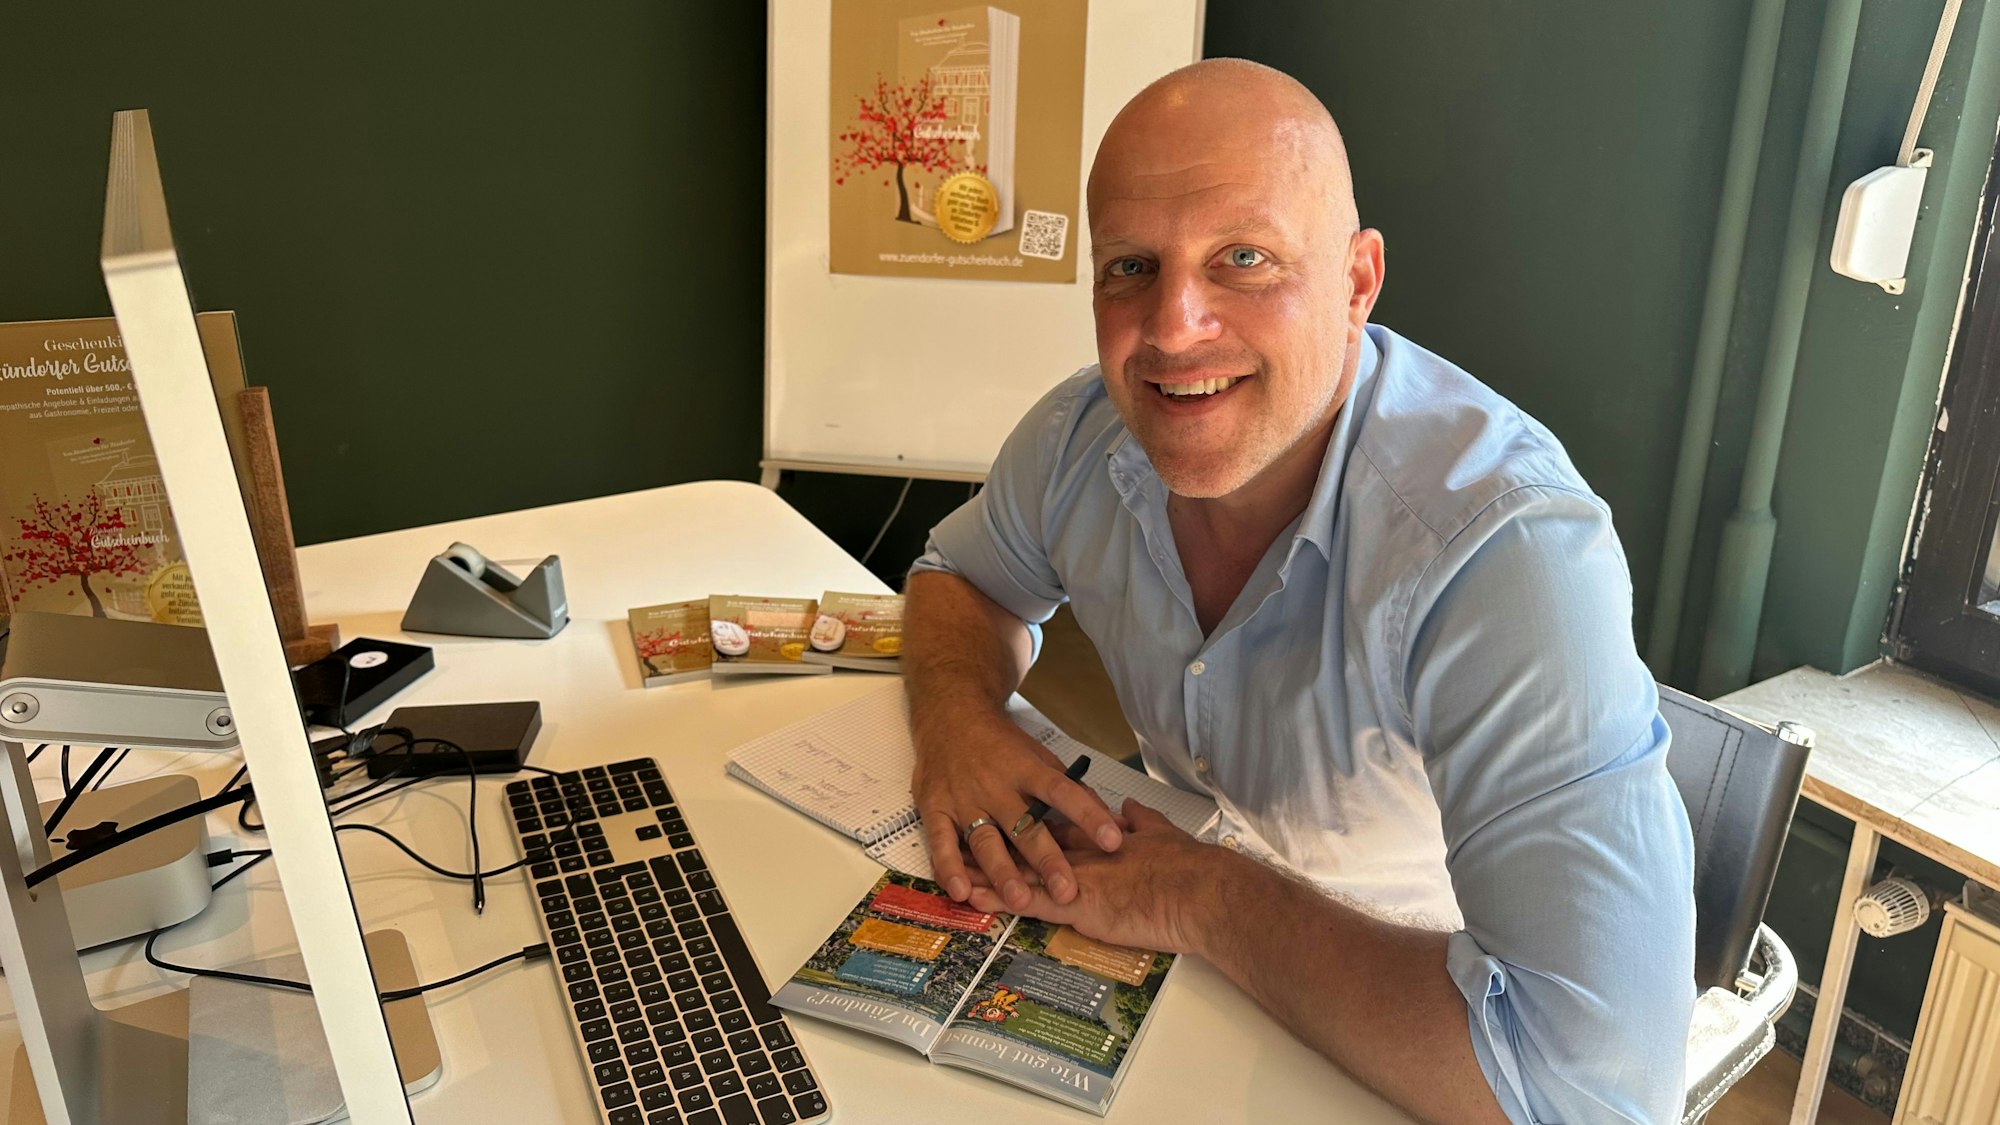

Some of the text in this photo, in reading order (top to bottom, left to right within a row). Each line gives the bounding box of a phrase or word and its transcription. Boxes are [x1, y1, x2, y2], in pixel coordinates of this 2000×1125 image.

[878, 252, 1024, 268] www.zuendorfer-gutscheinbuch.de
[0, 356, 80, 381] ündorfer
[46, 385, 84, 396] Potentiell
[85, 384, 103, 393] über
[43, 399, 78, 410] Angebote
[86, 395, 130, 405] Einladungen
[93, 405, 120, 414] Freizeit
[122, 404, 138, 412] oder
[91, 530, 169, 549] Gutscheinbuch
[806, 991, 901, 1024] Zündorf?
